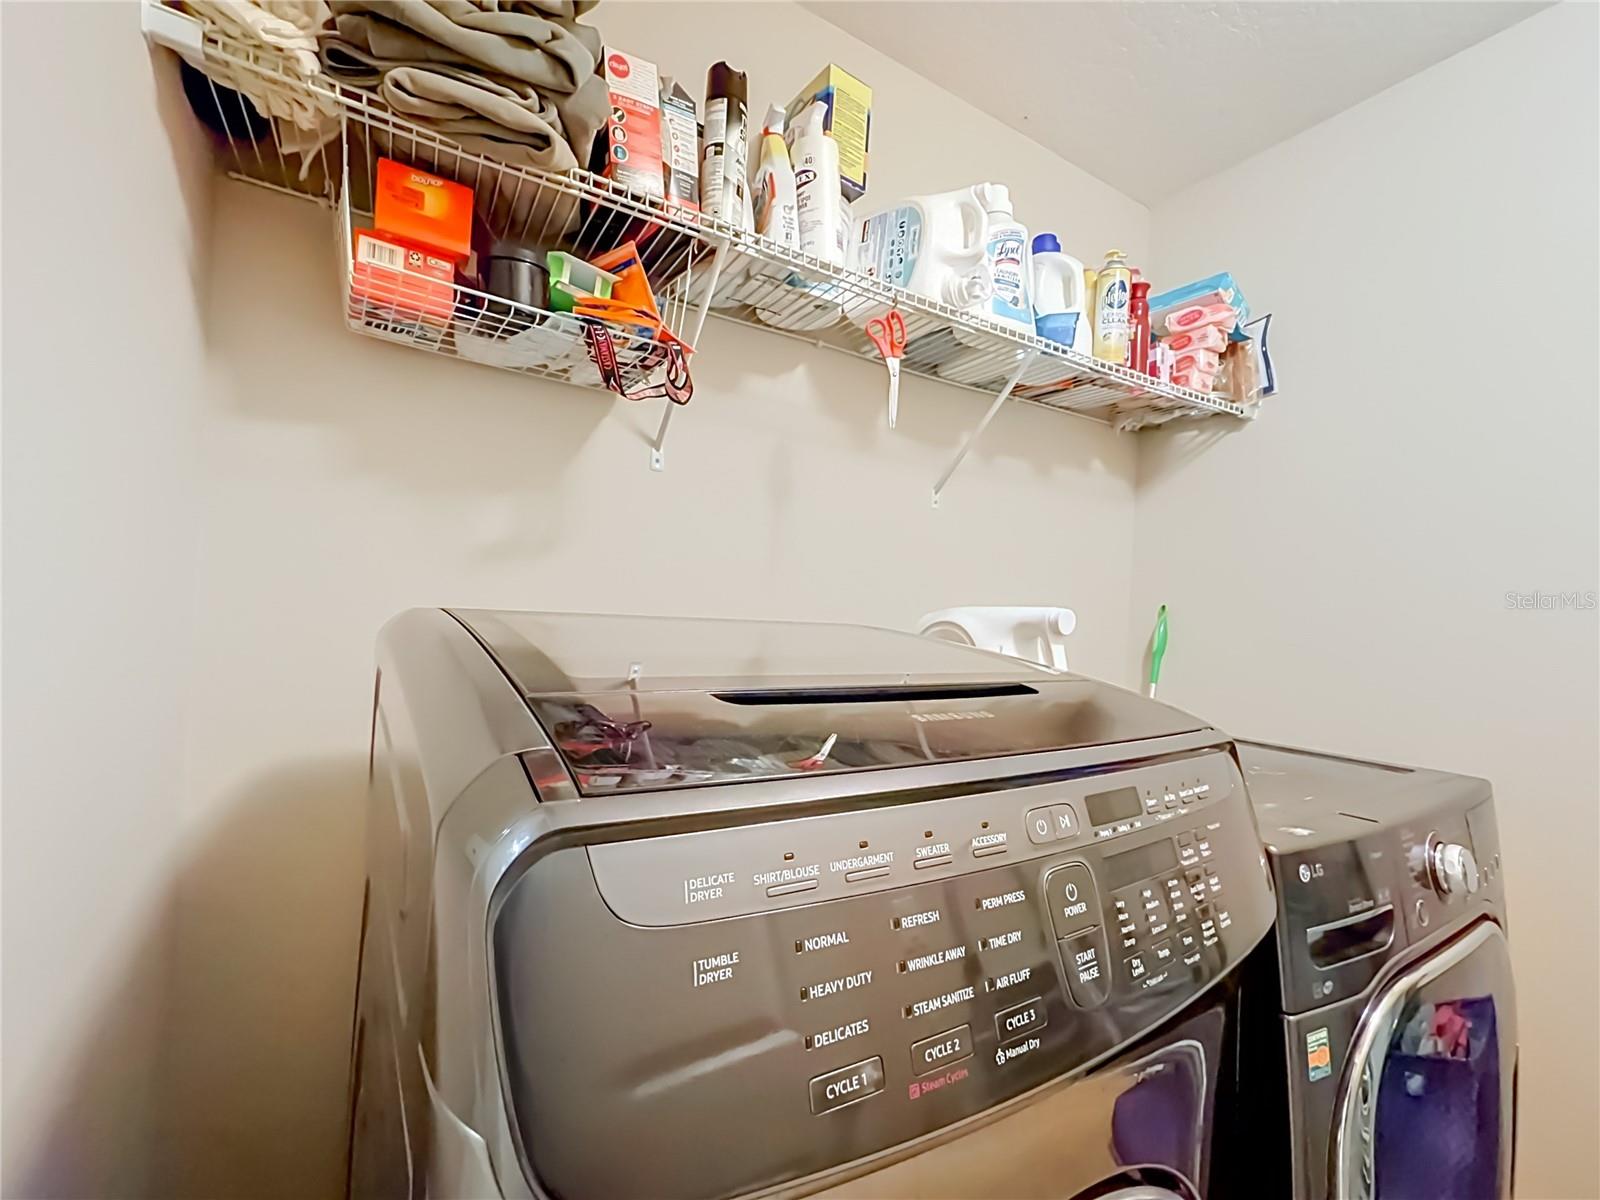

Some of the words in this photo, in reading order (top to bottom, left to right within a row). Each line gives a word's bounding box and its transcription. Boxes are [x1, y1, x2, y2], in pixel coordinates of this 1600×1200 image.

[916, 842, 950, 858] SWEATER
[971, 832, 1007, 848] ACCESSORY
[829, 851, 894, 873] UNDERGARMENT
[1310, 863, 1324, 878] LG
[689, 872, 735, 890] DELICATE
[753, 864, 820, 887] SHIRT/BLOUSE
[690, 887, 723, 903] DRYER
[982, 896, 1004, 911] PERM
[1003, 890, 1026, 906] PRESS
[901, 910, 940, 929] REFRESH
[1064, 902, 1087, 918] POWER
[804, 931, 849, 952] NORMAL
[988, 934, 1006, 950] TIME
[1006, 931, 1022, 946] DRY
[699, 952, 739, 971] TUMBLE
[907, 951, 945, 972] WRINKLE
[944, 946, 966, 965] AWAY
[1075, 948, 1096, 965] START
[699, 967, 733, 986] DRYER
[809, 978, 844, 999] HEAVY
[846, 970, 873, 989] DUTY
[995, 975, 1009, 990] AIR
[1009, 968, 1031, 986] FLUFF
[1079, 966, 1100, 984] PAUSE
[913, 997, 941, 1017] STEAM
[942, 986, 975, 1008] SANITIZE
[1006, 1012, 1029, 1031] CYCLE
[1029, 1008, 1036, 1021] 3
[814, 1019, 870, 1048] DELICATES
[924, 1042, 952, 1063] CYCLE
[952, 1038, 960, 1052] 2
[1005, 1042, 1028, 1061] Manual
[1028, 1036, 1041, 1052] Dry
[826, 1077, 858, 1100] CYCLE
[859, 1072, 868, 1088] 1
[921, 1076, 946, 1094] Steam
[946, 1068, 969, 1084] Cycles
